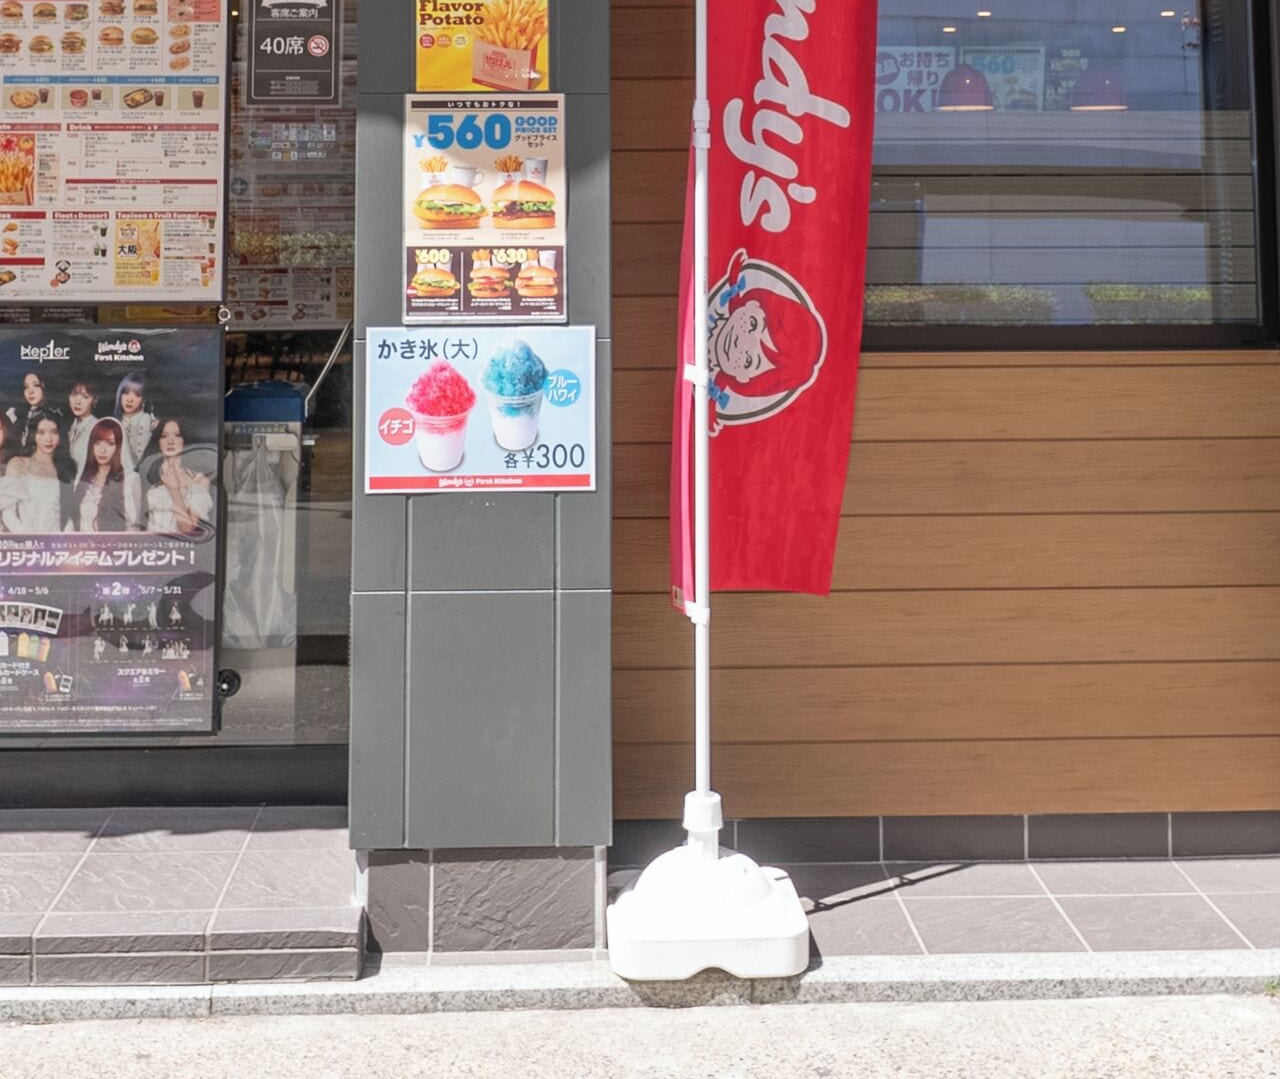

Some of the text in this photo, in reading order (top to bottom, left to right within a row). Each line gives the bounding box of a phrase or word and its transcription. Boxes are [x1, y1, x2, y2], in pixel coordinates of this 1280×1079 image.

[419, 0, 485, 13] Flavor
[270, 8, 318, 19] 客席ご案内
[419, 13, 485, 26] Potato
[260, 36, 305, 56] 40席
[899, 52, 950, 68] お持ち
[906, 70, 940, 86] 帰り
[69, 123, 92, 131] Drink
[515, 116, 558, 127] GOOD
[412, 114, 512, 151] ¥560
[514, 134, 558, 142] グッドプライス
[527, 141, 546, 149] セット
[117, 244, 138, 256] 大阪
[98, 341, 127, 354] Wendy's
[548, 375, 578, 389] ブルー
[548, 387, 579, 402] ハワイ
[379, 418, 415, 435] イチゴ
[475, 476, 493, 485] First
[494, 476, 523, 485] Kitchen
